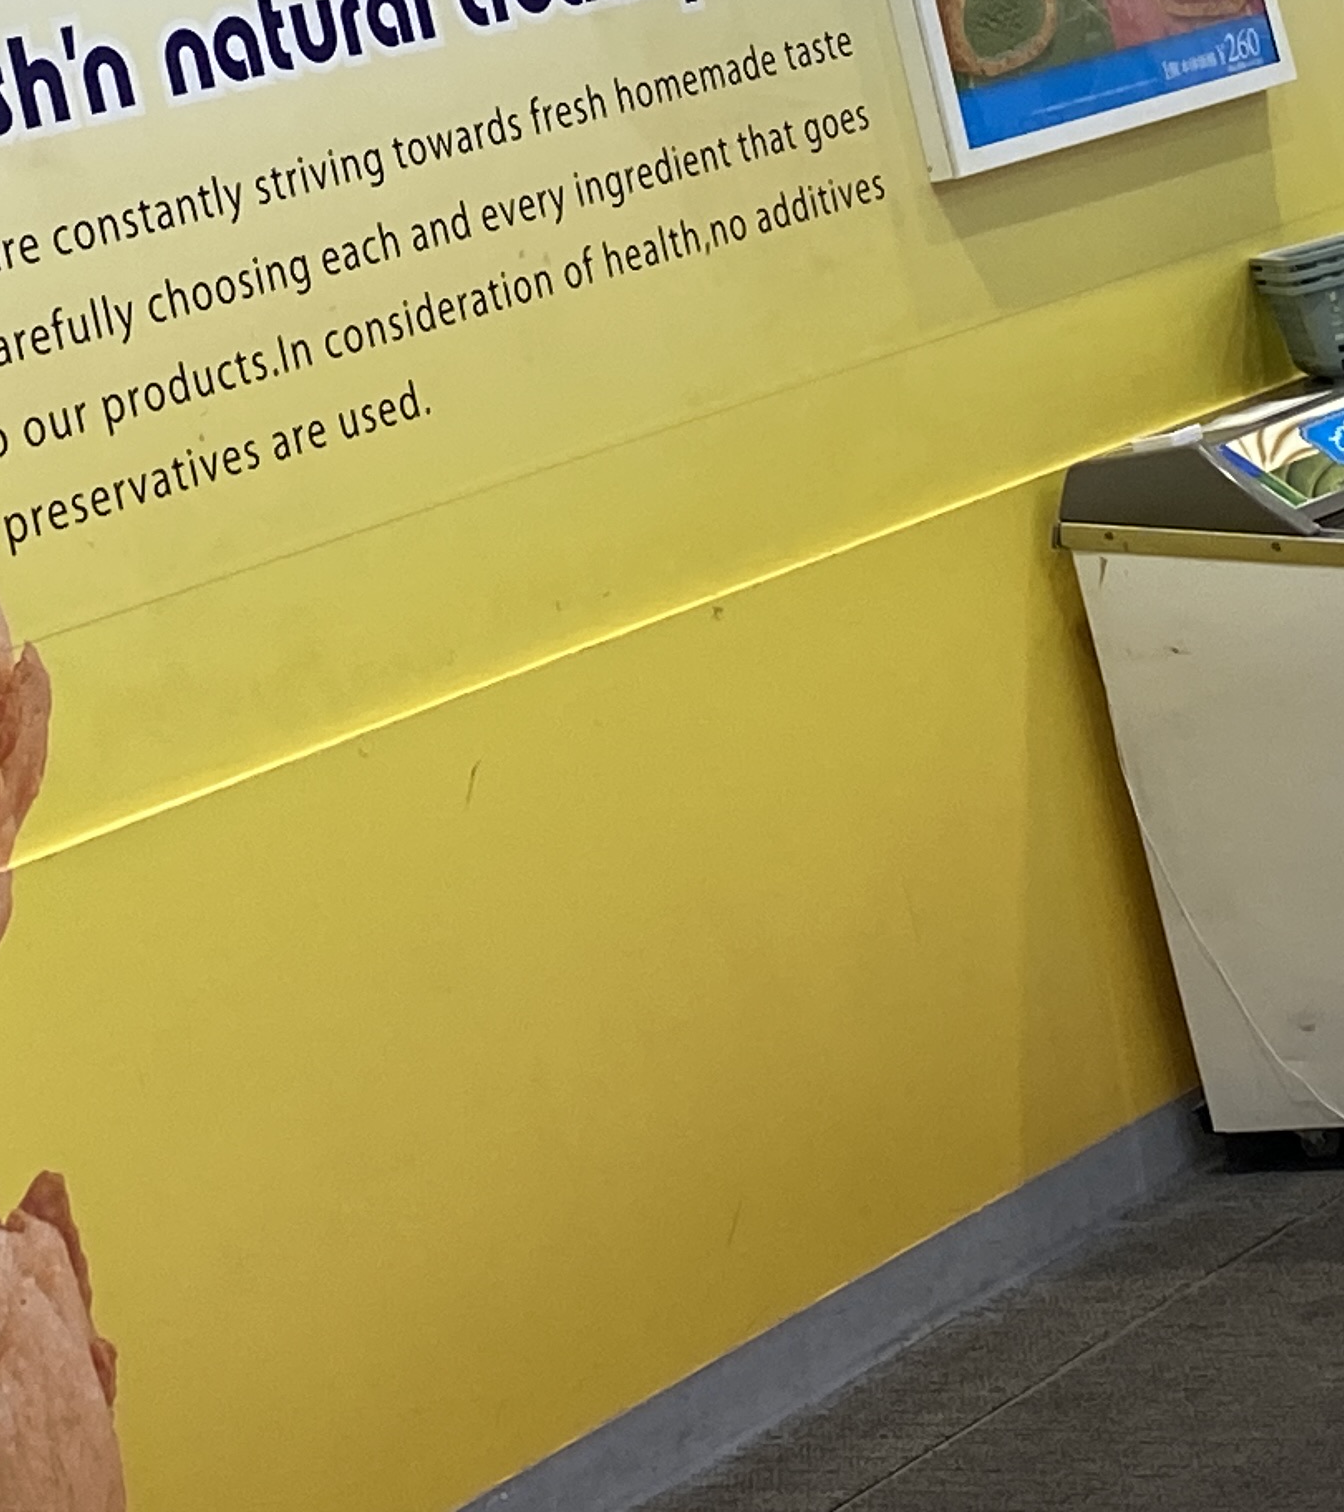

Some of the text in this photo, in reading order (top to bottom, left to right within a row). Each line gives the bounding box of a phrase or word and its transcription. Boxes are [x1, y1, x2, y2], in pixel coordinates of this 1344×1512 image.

[54, 176, 240, 255] constantly
[256, 149, 384, 204] striving
[392, 107, 521, 168] towards
[531, 85, 607, 134] fresh
[614, 45, 776, 113] homemade
[785, 32, 852, 70] taste
[149, 255, 311, 322] choosing
[323, 222, 400, 275] each
[412, 201, 471, 251] and
[482, 186, 563, 231] every
[574, 139, 731, 207] ingredient
[737, 122, 797, 162] that
[805, 106, 869, 153] goes
[24, 403, 85, 446] our
[326, 271, 553, 358] consideration
[565, 245, 592, 288] of
[757, 169, 887, 233] additives
[4, 441, 259, 556] preservatives
[273, 421, 326, 460] are
[339, 380, 430, 439] used.
